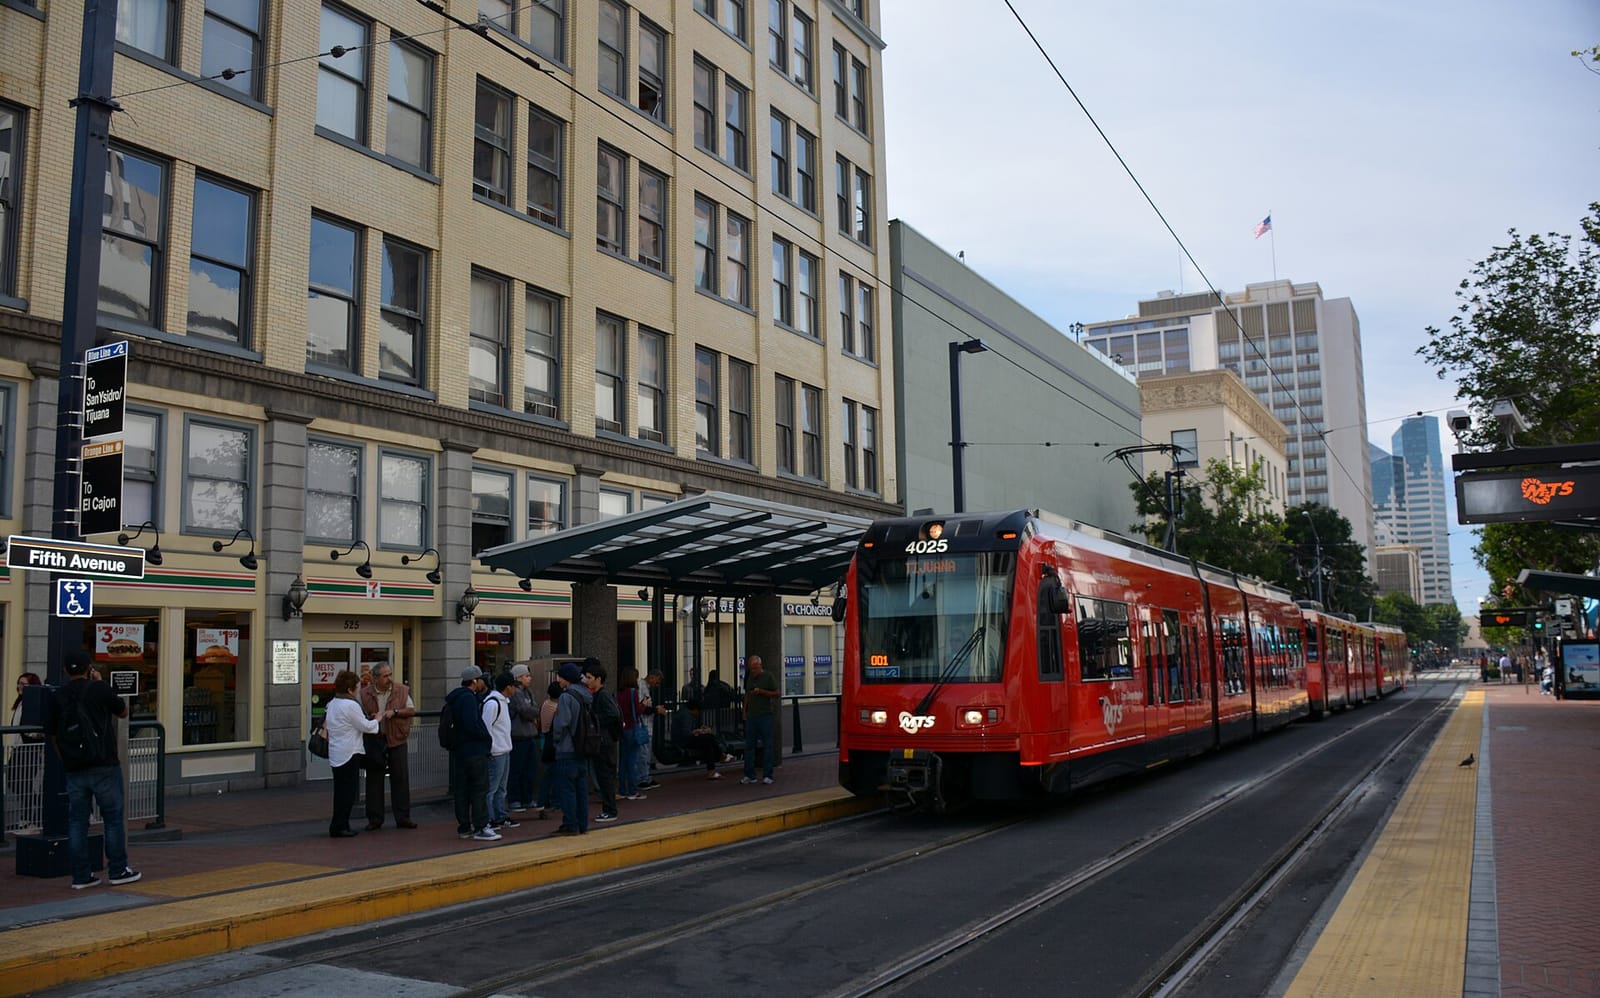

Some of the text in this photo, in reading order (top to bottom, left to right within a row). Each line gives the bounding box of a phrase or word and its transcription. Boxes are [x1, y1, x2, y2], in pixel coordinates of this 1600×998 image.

[88, 347, 111, 361] Blue Line
[87, 377, 96, 390] To
[86, 386, 123, 407] San Ysidro/
[85, 408, 110, 424] Tijuana
[84, 443, 114, 457] Orange Line
[83, 481, 92, 495] To
[1522, 480, 1575, 499] MTS
[83, 495, 116, 512] El Cajon
[905, 539, 948, 554] 4025
[29, 549, 126, 572] Fifth Avenue
[905, 560, 956, 575] TIJUANA
[795, 604, 833, 616] CHONGRO
[343, 620, 360, 630] 525
[314, 663, 335, 671] MELTS
[870, 655, 889, 666] 001
[899, 715, 936, 729] MTS
